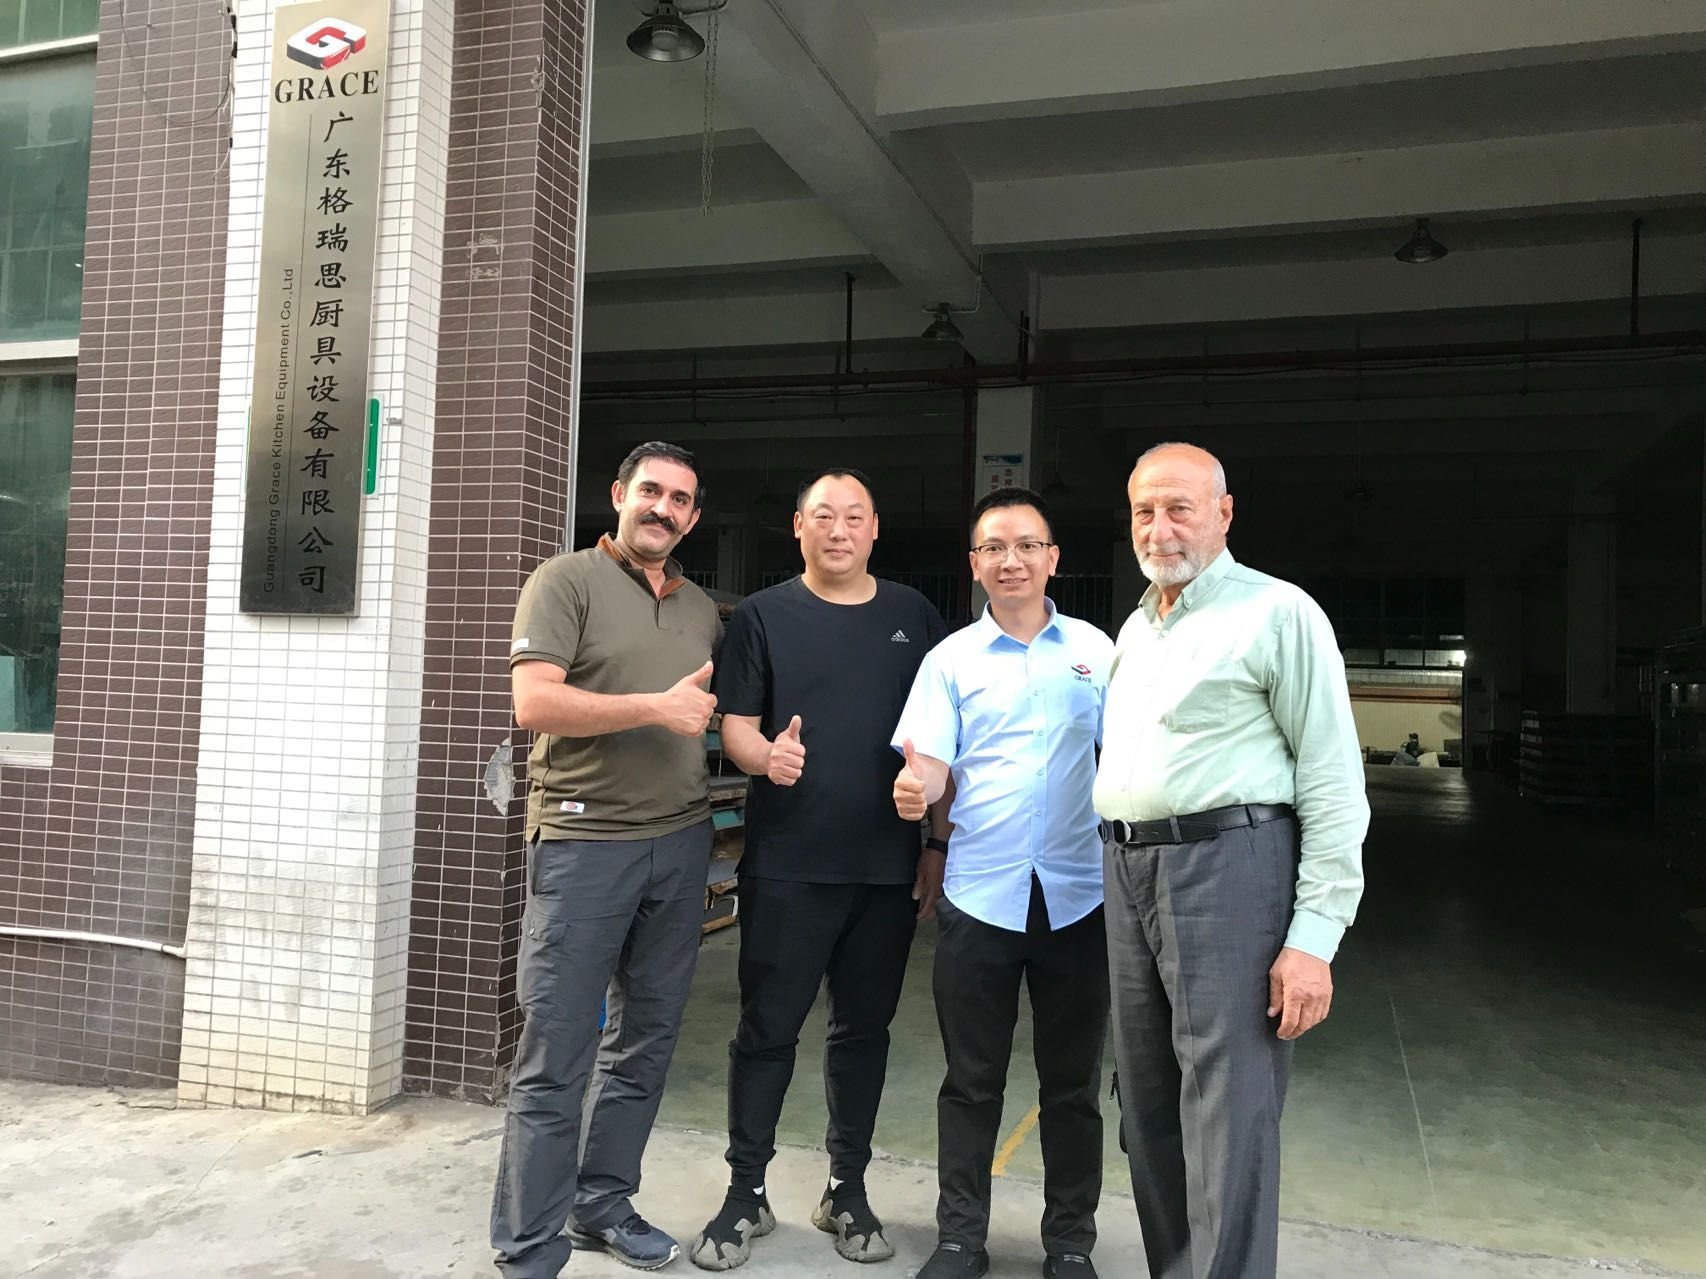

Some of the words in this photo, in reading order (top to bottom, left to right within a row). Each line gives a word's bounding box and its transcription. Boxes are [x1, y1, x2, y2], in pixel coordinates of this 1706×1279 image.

[274, 70, 379, 104] GRACE
[276, 324, 290, 400] Equipment
[298, 111, 354, 594] 广东格瑞思厨具设备有限公司
[271, 404, 285, 458] Kitchen
[268, 462, 281, 505] Grace
[264, 508, 281, 593] Guangdong
